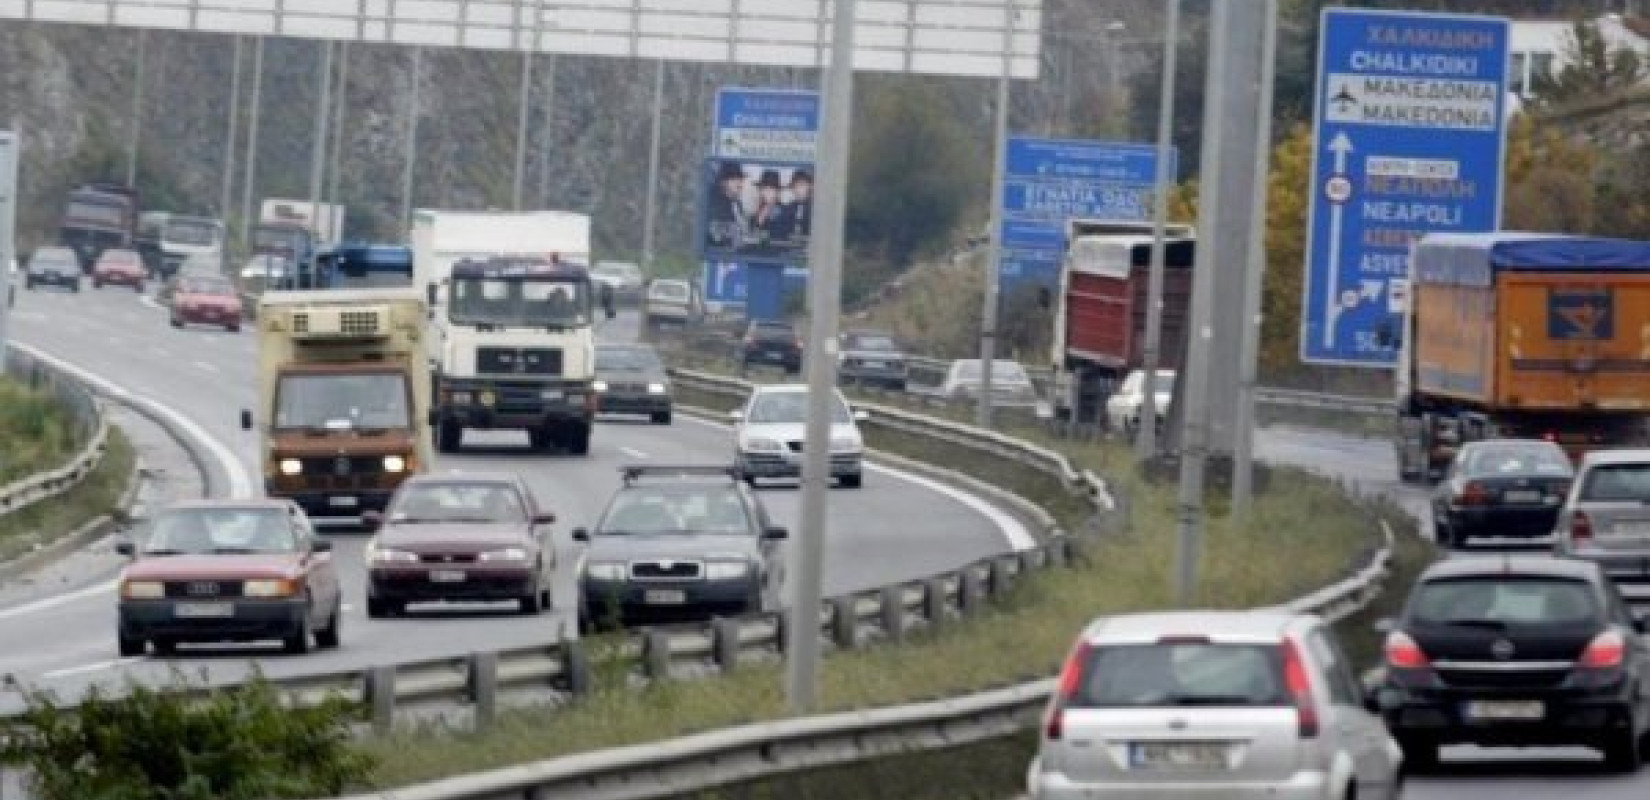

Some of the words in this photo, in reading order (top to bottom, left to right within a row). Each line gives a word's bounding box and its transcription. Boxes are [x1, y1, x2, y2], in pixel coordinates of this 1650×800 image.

[1351, 50, 1478, 75] CHALKIDIKI
[1362, 102, 1494, 127] MAKEDONIA
[1363, 201, 1462, 226] NEAPOLI
